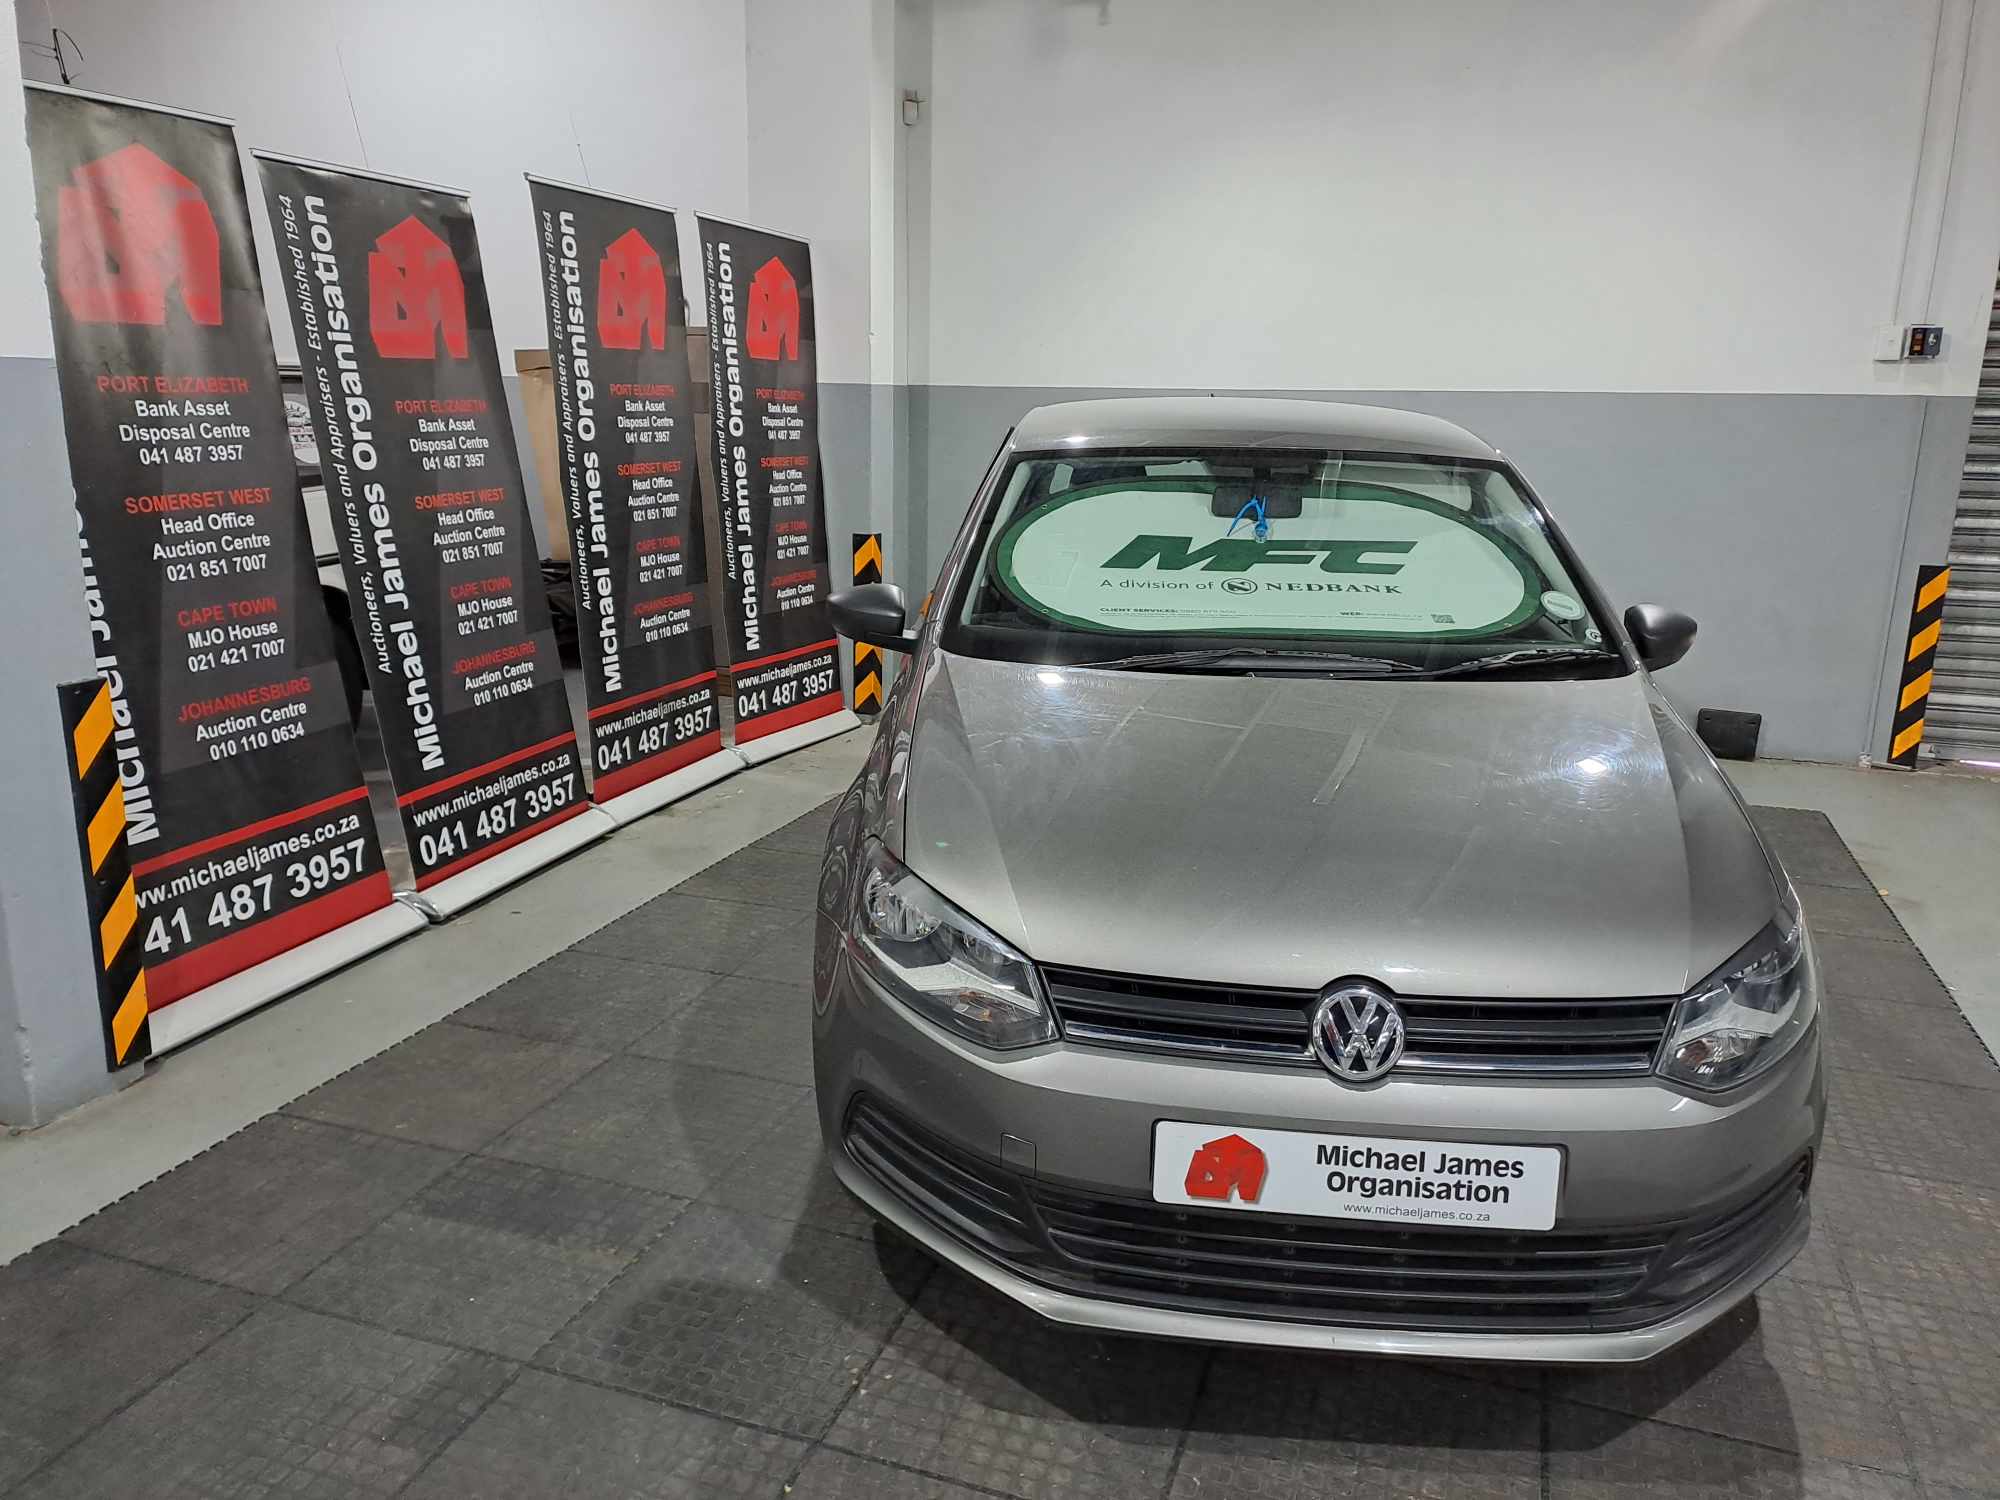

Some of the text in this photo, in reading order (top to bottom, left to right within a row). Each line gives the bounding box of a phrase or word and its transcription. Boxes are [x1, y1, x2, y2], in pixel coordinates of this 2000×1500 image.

[97, 376, 249, 393] PORT ELIZABETH
[610, 384, 632, 396] PORT
[135, 400, 231, 416] Bank Asset
[395, 400, 427, 414] PORT
[542, 210, 591, 610] Auctioneers, Valuers and Appraisers Established 1964
[625, 400, 665, 412] Bank Asset
[706, 242, 737, 580] Auctioneers, Valuers and Appraisers Established 1964
[118, 423, 250, 443] Disposal Centre
[278, 194, 392, 673] Auctioneers, Valuers and Appraisers Established 1964
[418, 418, 475, 433] Bank Asset
[617, 416, 674, 429] Disposal Centre
[409, 436, 489, 453] Disposal Centre
[625, 431, 670, 443] 041 487 3957
[139, 445, 243, 464] 041 487 3957
[422, 454, 485, 470] 041 487 3957
[633, 477, 673, 491] Head Office
[733, 445, 751, 536] James
[125, 488, 272, 513] SOMERSET WEST
[415, 488, 505, 509] SOMERSET WEST
[583, 451, 608, 558] James
[628, 492, 680, 507] Auction Centre
[161, 512, 255, 535] Head Office
[437, 508, 495, 526] Head Office
[633, 510, 646, 522] 021
[661, 506, 677, 518] 7007
[153, 533, 270, 560] Auction Centre
[364, 483, 409, 610] James
[433, 525, 505, 546] Auction Centre
[442, 542, 503, 563] 021 851 7007
[657, 552, 680, 564] House
[1100, 534, 1418, 575] MFC
[167, 554, 267, 581] 021 851 7007
[640, 565, 682, 583] 021 421 7007
[450, 576, 512, 598] CAPE TOWN
[738, 544, 760, 652] Michael
[1100, 579, 1403, 594] A division of NEDBANK
[177, 597, 278, 627] CAPE TOWN
[457, 596, 513, 617] MJO House
[640, 608, 690, 629] Auction Centre
[187, 621, 278, 649] MJO House
[458, 610, 518, 636] 021 421 7007
[592, 567, 621, 693] Michael
[646, 630, 658, 642] 010
[659, 626, 671, 639] 110
[188, 639, 285, 672] 021 421 7007
[465, 661, 534, 691] Auction Centre
[737, 654, 832, 689] www.michaeljames.co.za
[178, 677, 312, 721] JOHANNESBURG
[389, 620, 444, 771] Michael
[474, 678, 533, 706] 010 110 0634
[738, 669, 834, 717] 041 487 3957
[196, 702, 307, 742] Auction Centre
[596, 689, 710, 738] www.michaeljames.co.za
[210, 722, 305, 760] 010 110 0634
[598, 705, 712, 770] 041 487 3957
[413, 753, 571, 827] www.michaeljames.co.za
[419, 773, 575, 866] 041 487 3957
[144, 837, 367, 954] 41 487 3957
[1316, 1144, 1524, 1179] Michael James
[1327, 1171, 1510, 1203] Organisation
[1343, 1203, 1490, 1222] www.michaeljames.co.za
